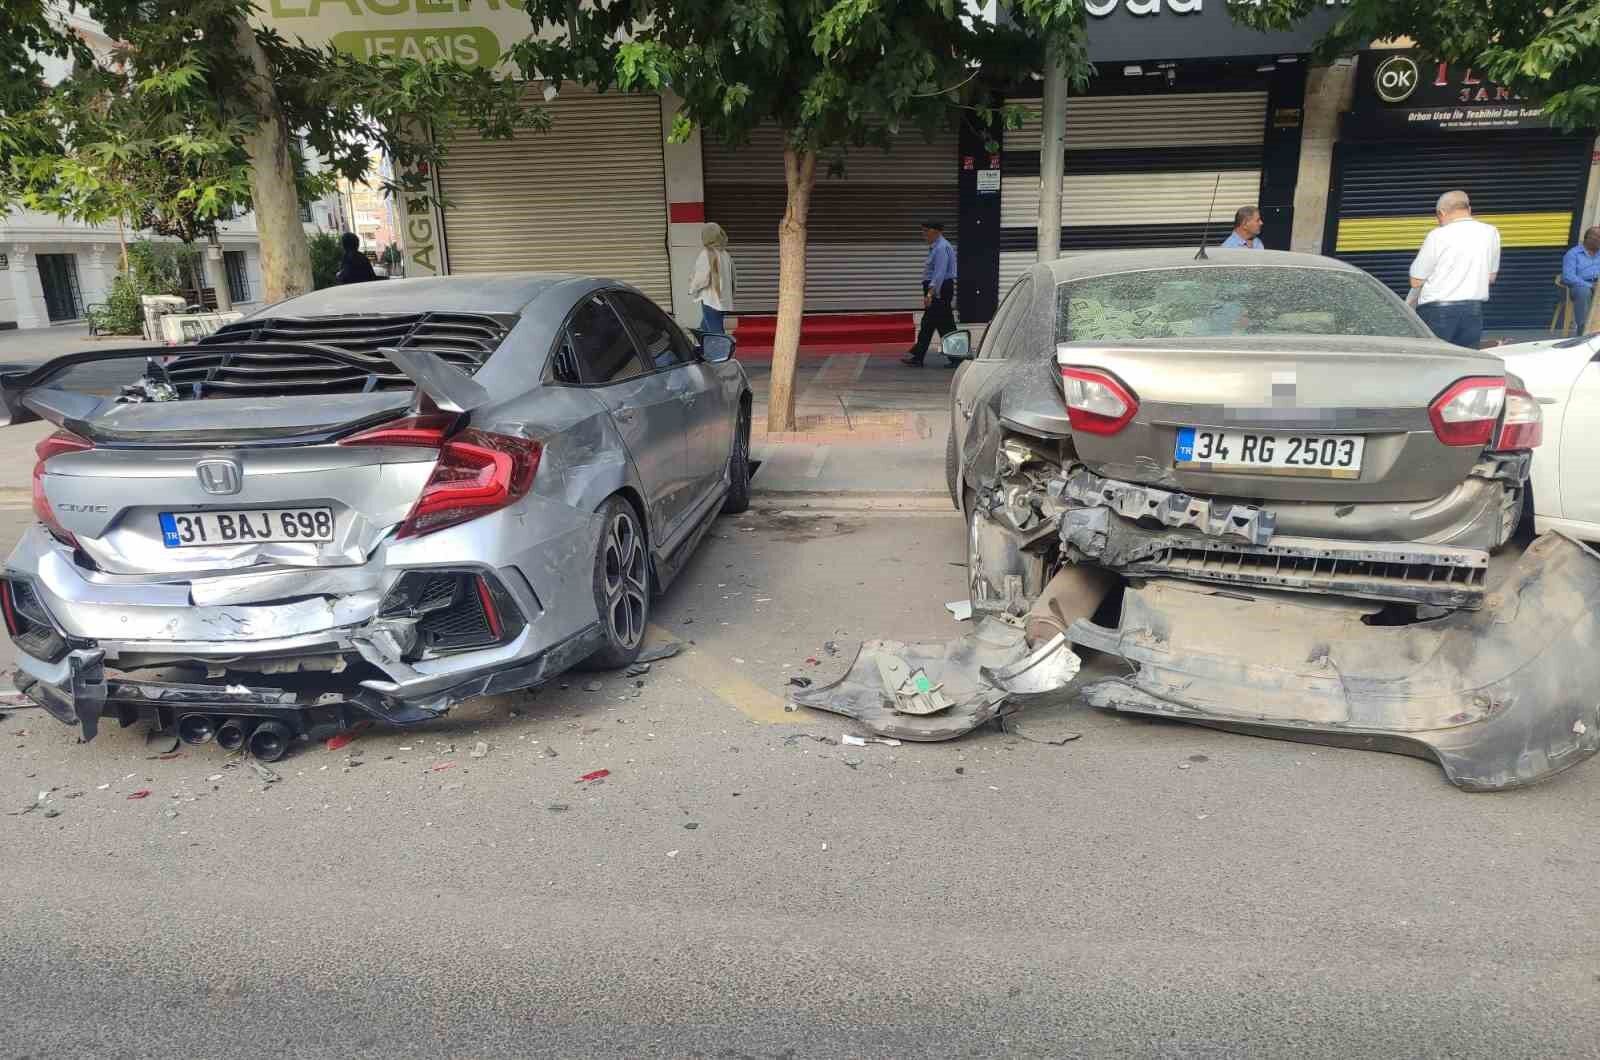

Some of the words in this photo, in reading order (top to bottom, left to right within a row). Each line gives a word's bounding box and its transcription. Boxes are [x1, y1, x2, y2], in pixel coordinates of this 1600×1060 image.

[1382, 70, 1412, 88] OK
[1180, 446, 1192, 455] TR
[1197, 432, 1229, 460] 34
[1240, 434, 1276, 463] RG
[1284, 436, 1355, 466] 2503
[55, 503, 109, 513] CIVIC
[176, 515, 207, 543] 31
[217, 512, 273, 541] BAJ
[279, 510, 332, 539] 698
[167, 532, 178, 540] TR
